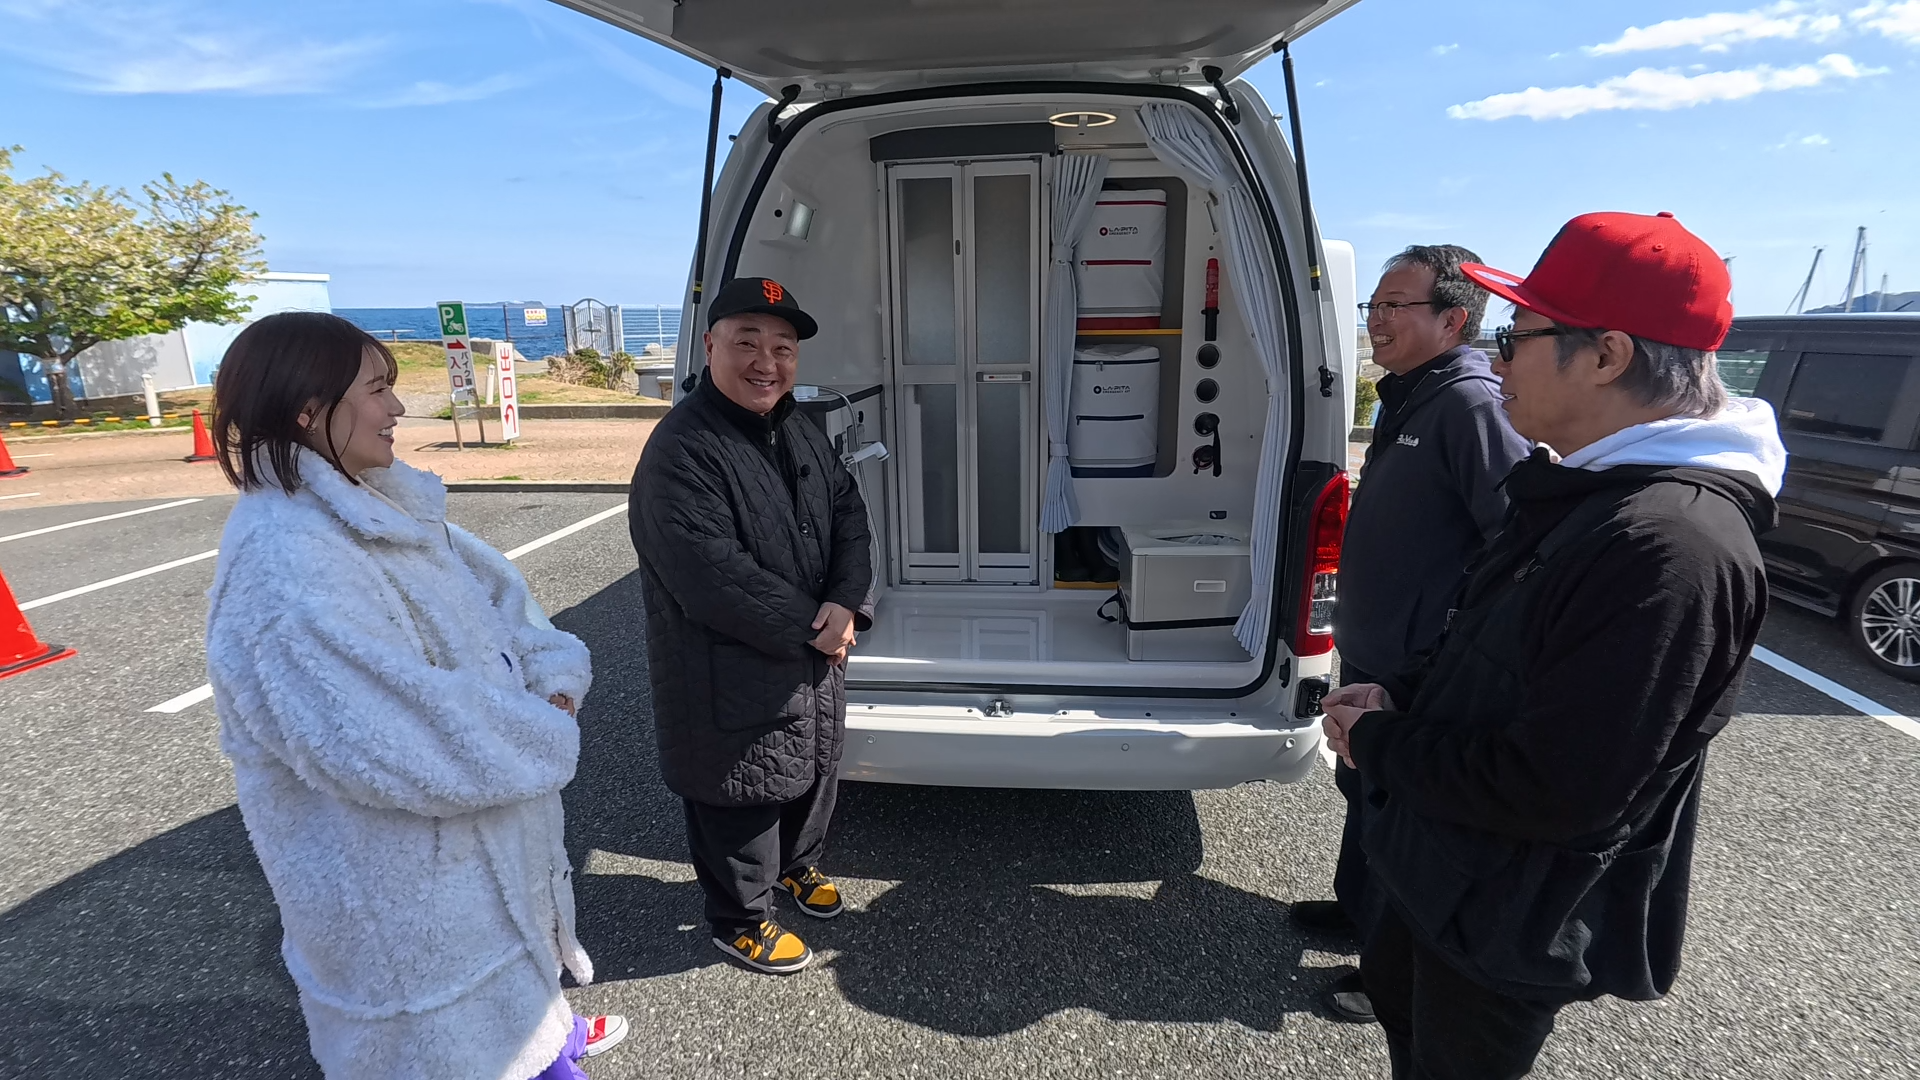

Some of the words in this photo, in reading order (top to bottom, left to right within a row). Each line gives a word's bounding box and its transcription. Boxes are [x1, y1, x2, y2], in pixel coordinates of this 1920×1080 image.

[761, 279, 784, 304] SF
[441, 306, 454, 326] P
[450, 356, 464, 388] 入口
[500, 347, 514, 399] 出口
